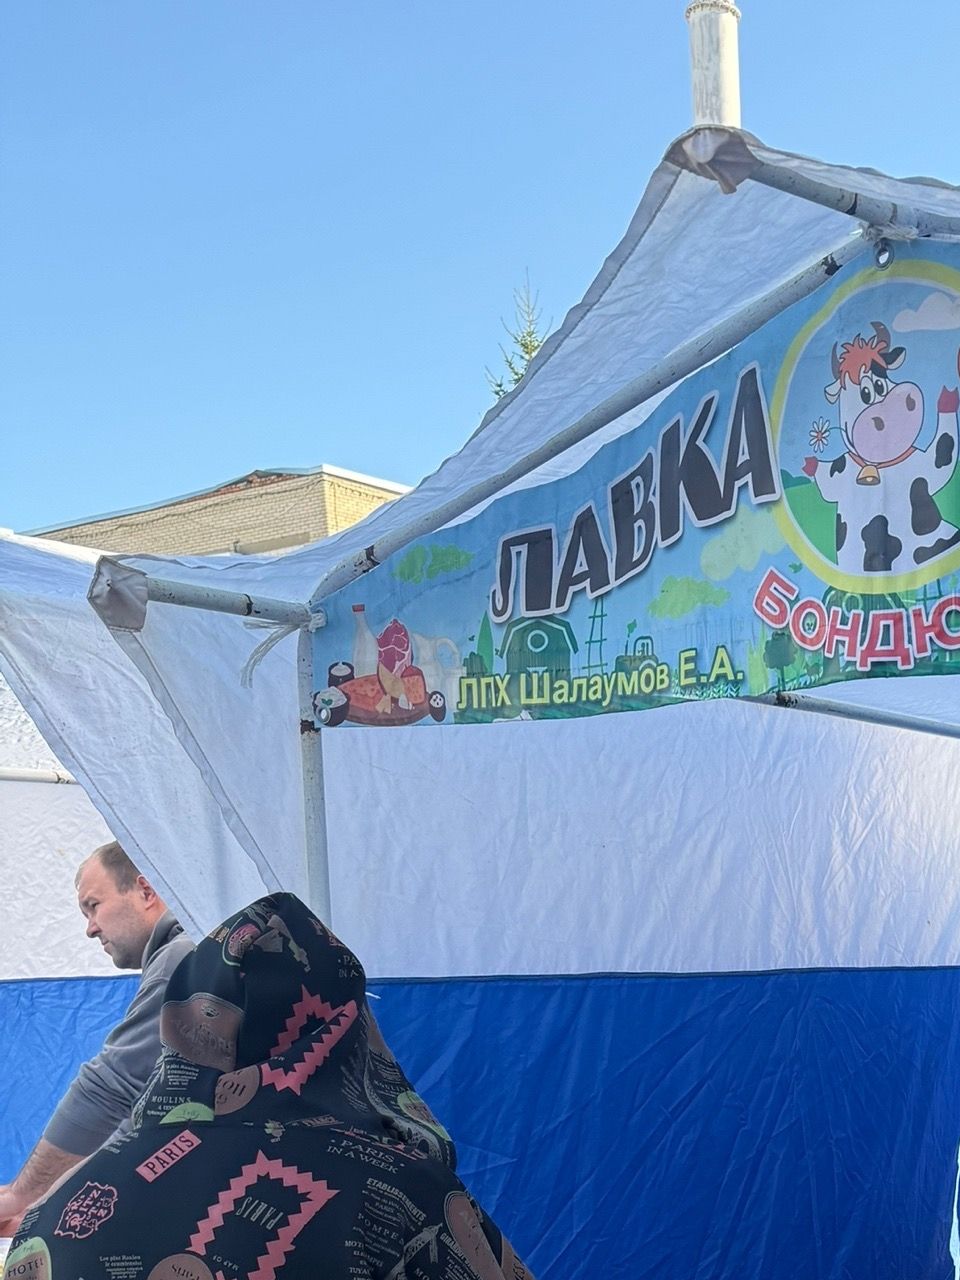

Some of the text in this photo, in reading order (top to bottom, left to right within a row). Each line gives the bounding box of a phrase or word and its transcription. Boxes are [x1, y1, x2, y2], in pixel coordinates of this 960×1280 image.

[490, 365, 781, 624] ЛАВКА
[458, 645, 744, 709] ЛПХ Шалаумов Е.А.
[144, 1135, 194, 1176] PARIS
[340, 1140, 395, 1163] PARIS
[234, 1196, 284, 1230] PARIS
[8, 1257, 44, 1278] HOTEL
